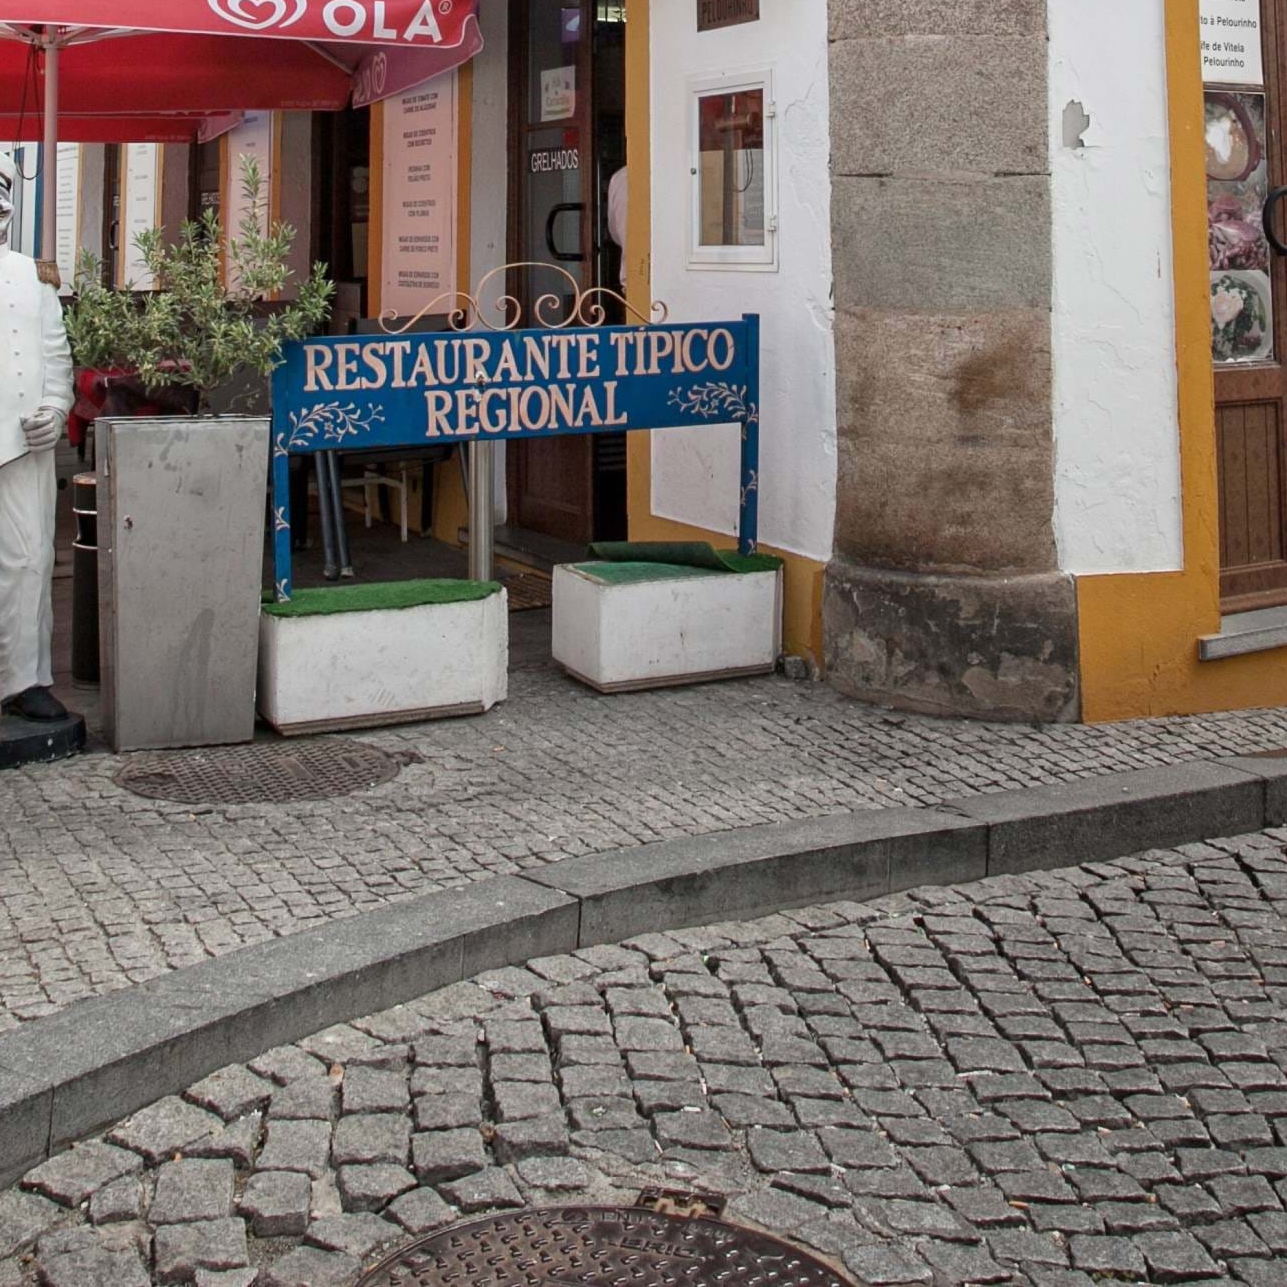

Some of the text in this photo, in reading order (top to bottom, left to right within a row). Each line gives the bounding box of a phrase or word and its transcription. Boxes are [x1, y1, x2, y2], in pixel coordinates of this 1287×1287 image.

[1217, 16, 1257, 29] Pelourinho
[1204, 57, 1244, 68] Pelourinho
[531, 148, 579, 173] GRELHADOS
[303, 326, 735, 393] RESTAURANTE TÍPICO
[424, 381, 628, 437] REGIONAL
